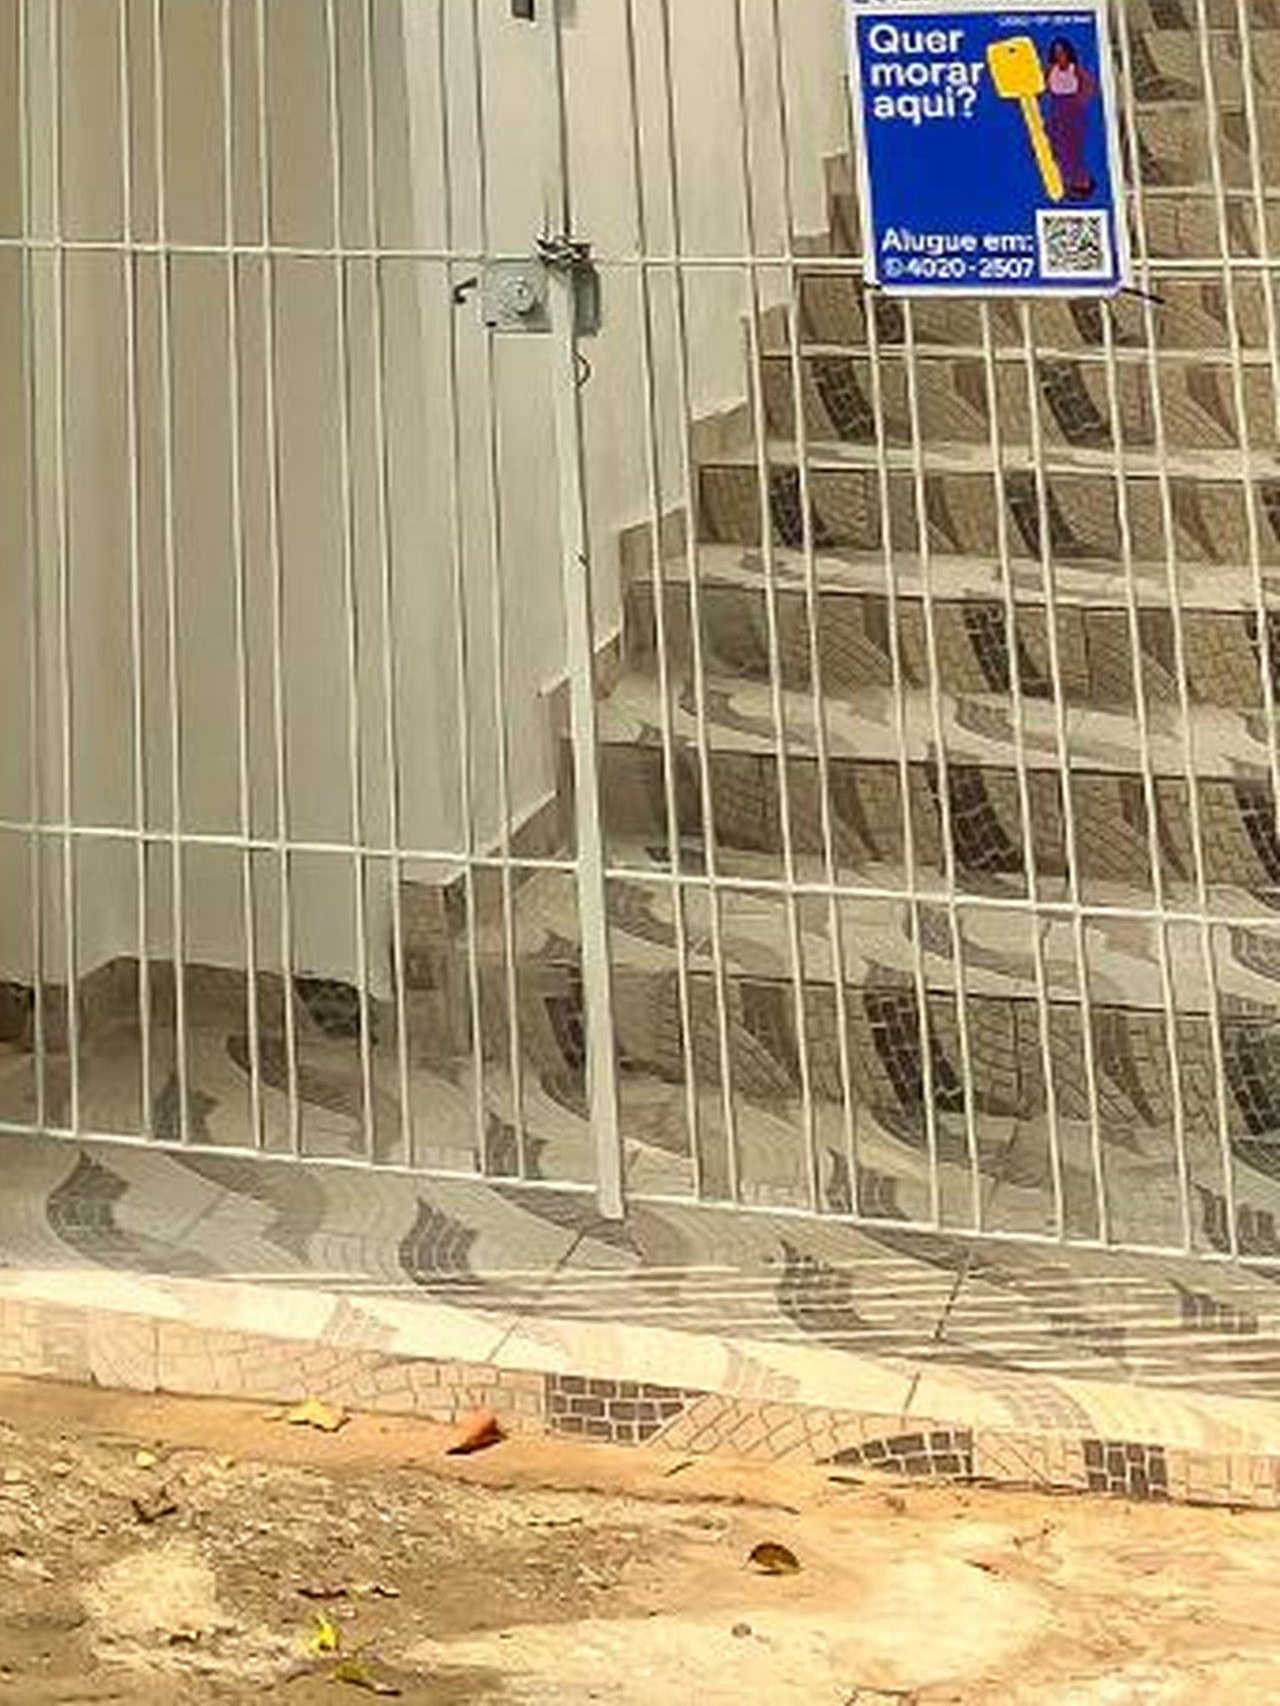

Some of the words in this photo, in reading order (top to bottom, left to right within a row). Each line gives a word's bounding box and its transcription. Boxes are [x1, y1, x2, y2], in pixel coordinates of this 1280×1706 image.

[869, 24, 964, 53] Quer
[871, 61, 985, 87] morar
[873, 86, 978, 126] aqui?
[881, 227, 978, 255] Alugue
[983, 235, 1034, 252] em:
